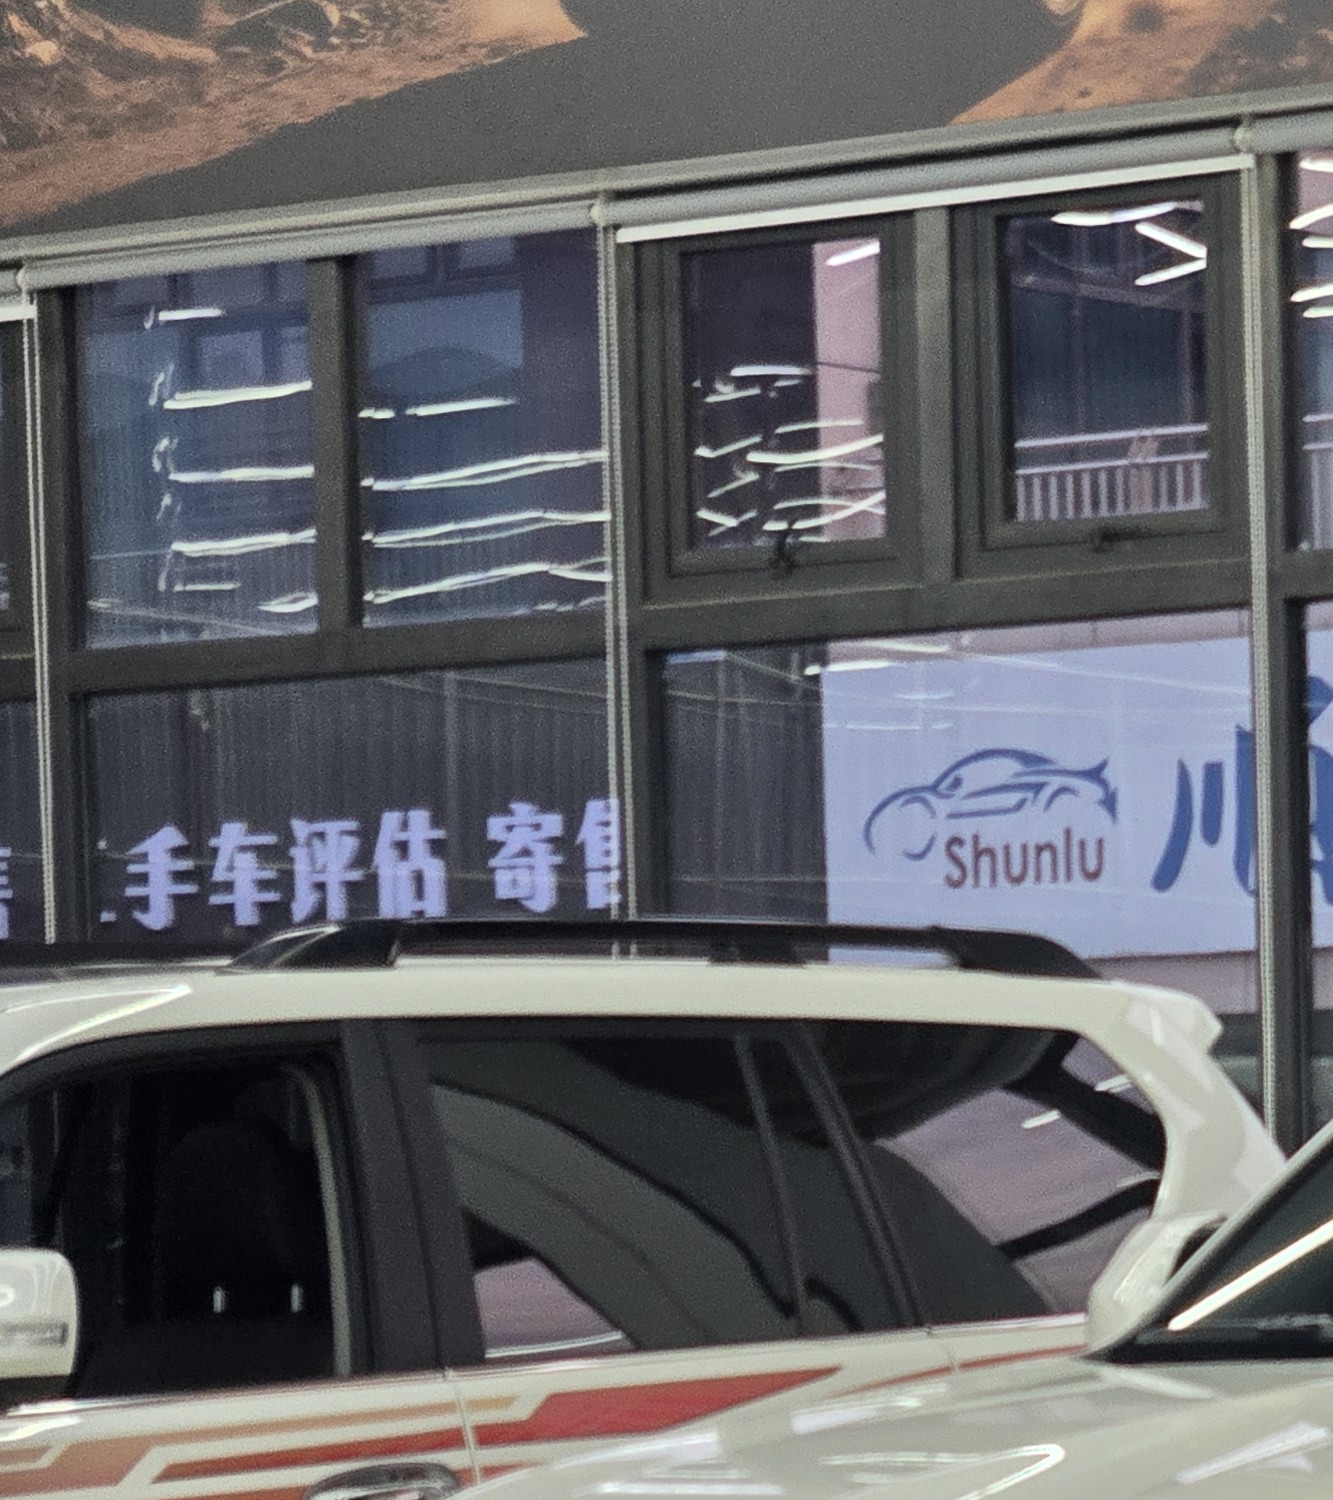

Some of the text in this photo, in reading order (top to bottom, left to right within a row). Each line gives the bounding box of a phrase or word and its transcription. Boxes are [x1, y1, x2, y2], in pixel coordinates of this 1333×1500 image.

[97, 809, 448, 931] 手车评估
[943, 827, 1105, 890] Shunlu
